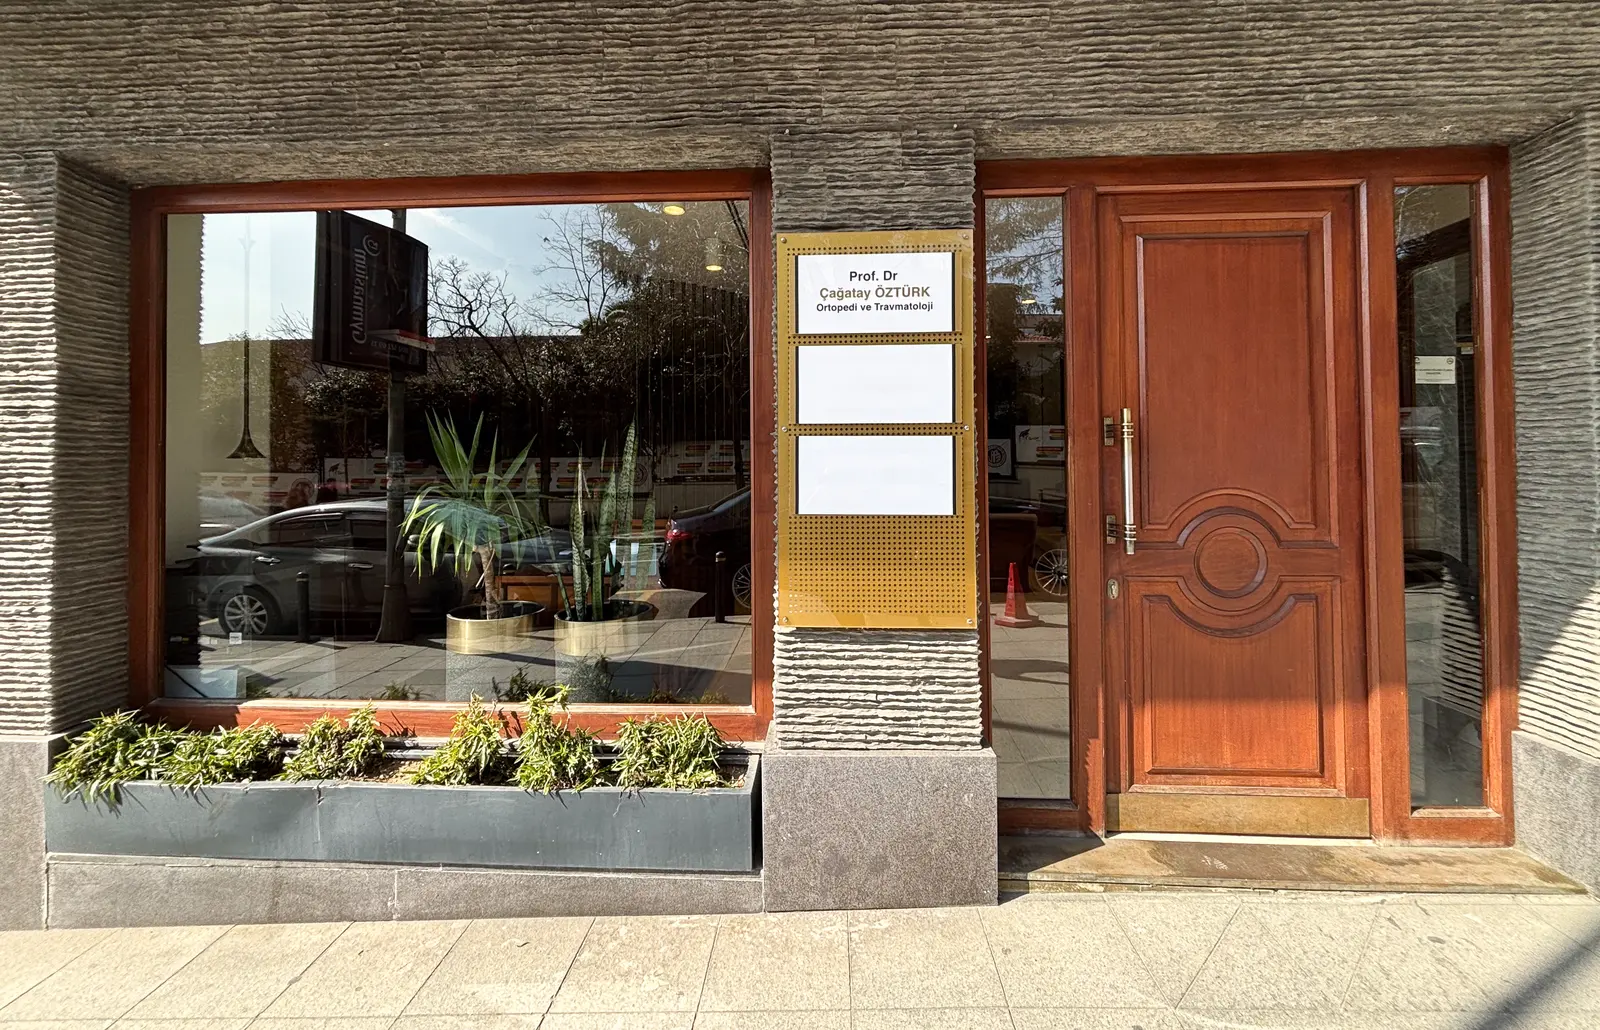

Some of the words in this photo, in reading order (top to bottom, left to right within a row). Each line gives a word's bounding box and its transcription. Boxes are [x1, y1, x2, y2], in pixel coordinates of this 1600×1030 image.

[849, 271, 879, 282] Prof.
[883, 270, 898, 281] Dr
[819, 287, 871, 301] Çağatay
[875, 285, 930, 298] ÖZTÜRK
[816, 303, 858, 313] Ortopedi
[874, 302, 933, 312] Travmatoloji
